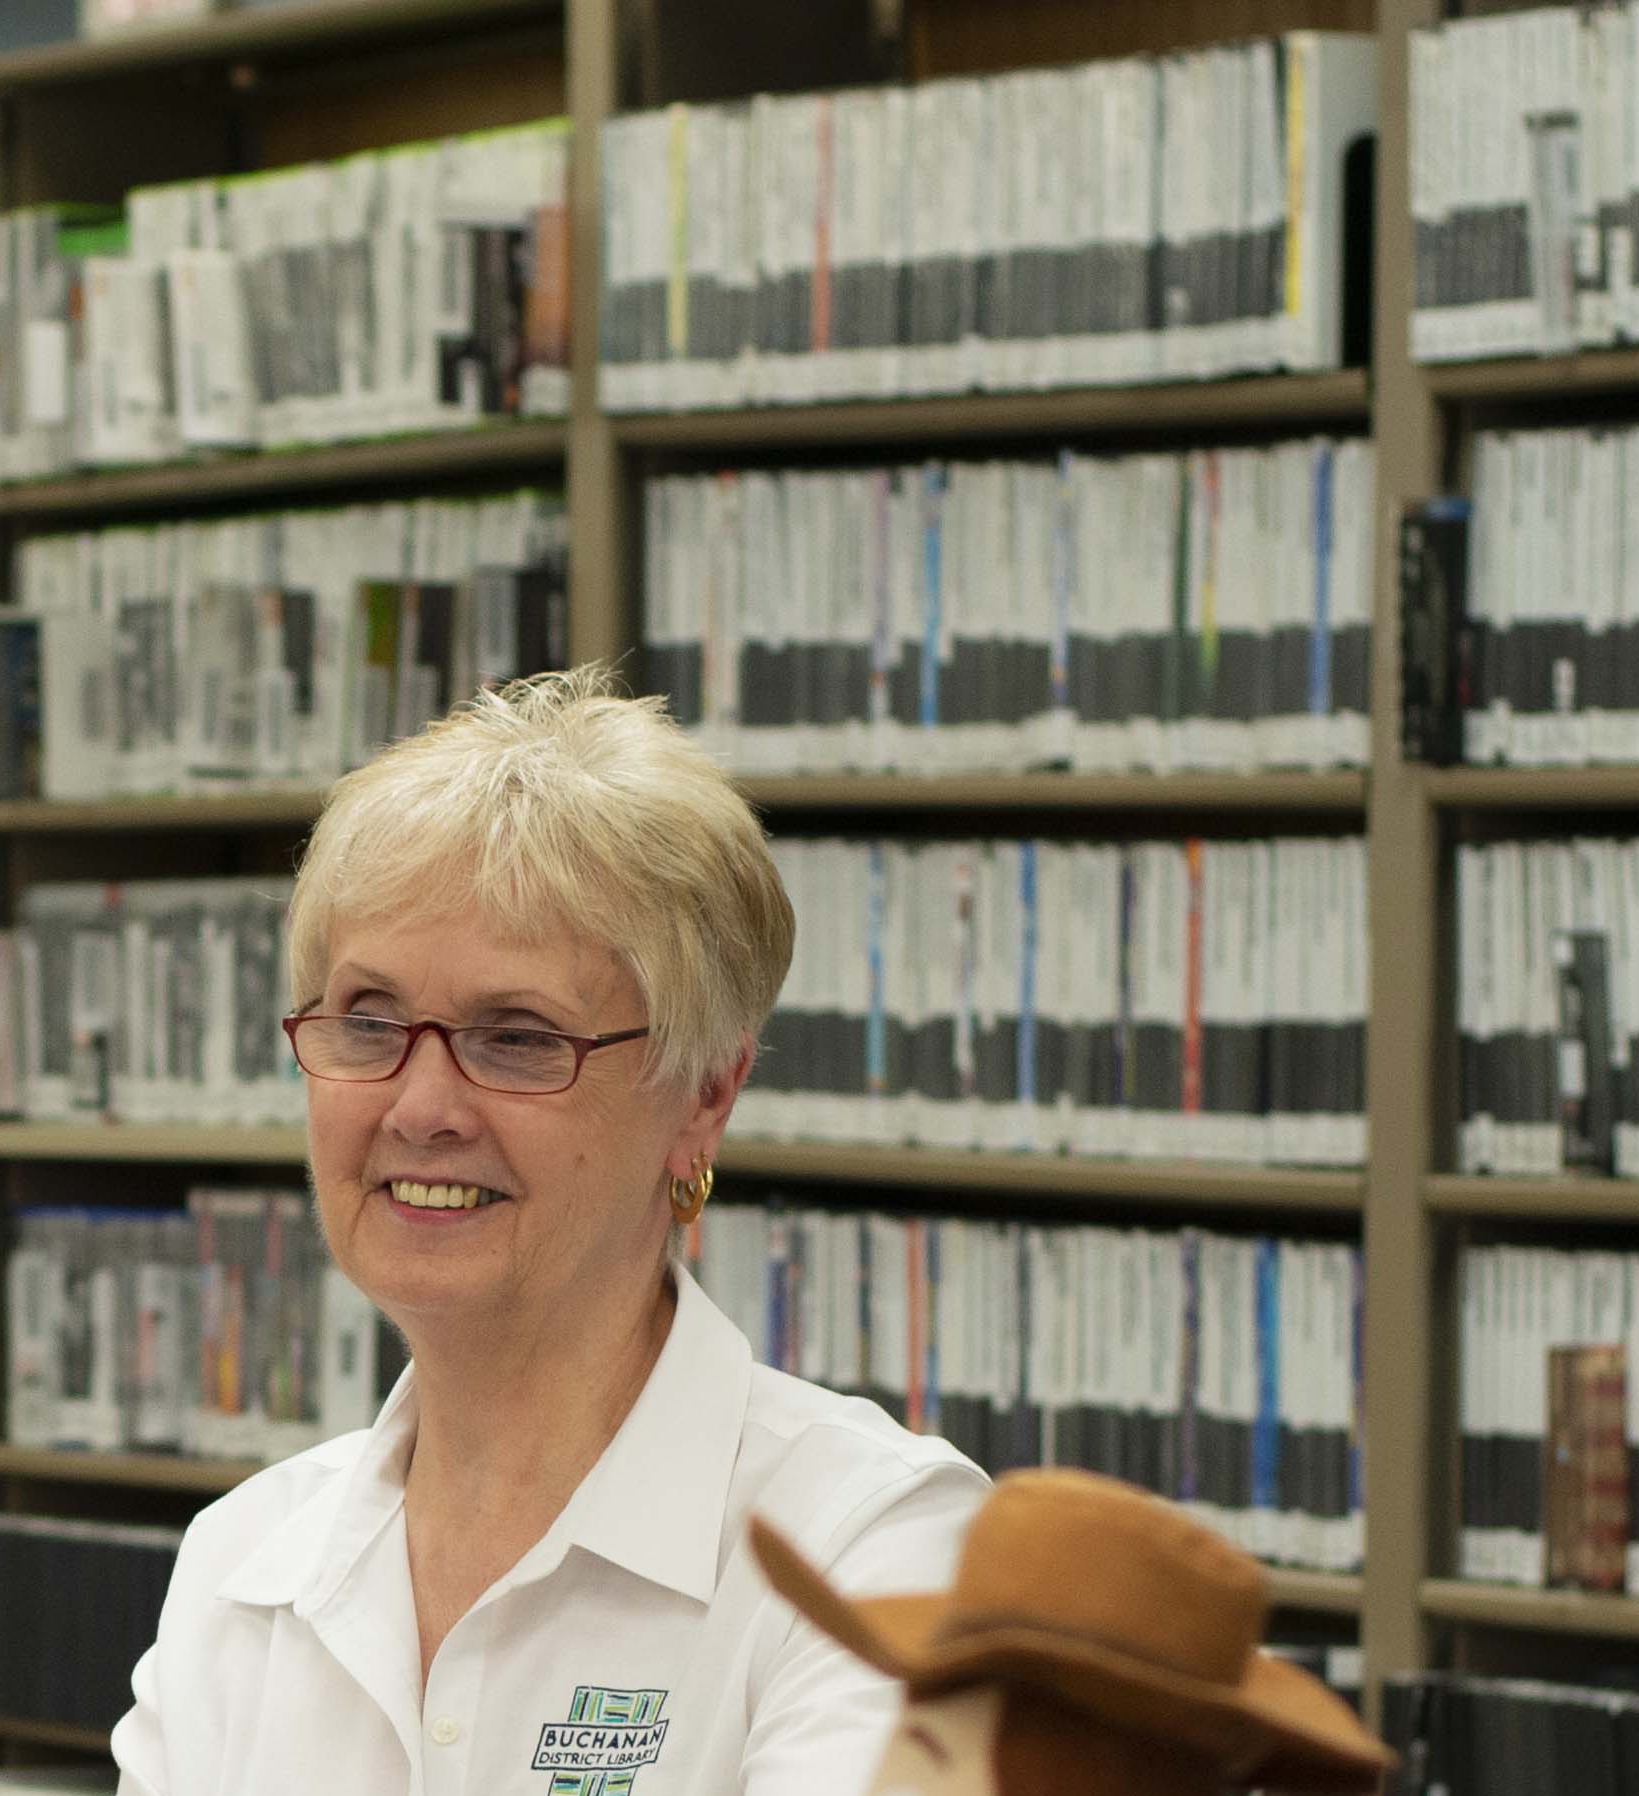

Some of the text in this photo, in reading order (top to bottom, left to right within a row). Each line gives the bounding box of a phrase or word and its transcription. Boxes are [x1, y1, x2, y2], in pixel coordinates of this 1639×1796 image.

[544, 1725, 663, 1749] BUCHANAN
[538, 1747, 656, 1766] DISTRICT LIBRARY
